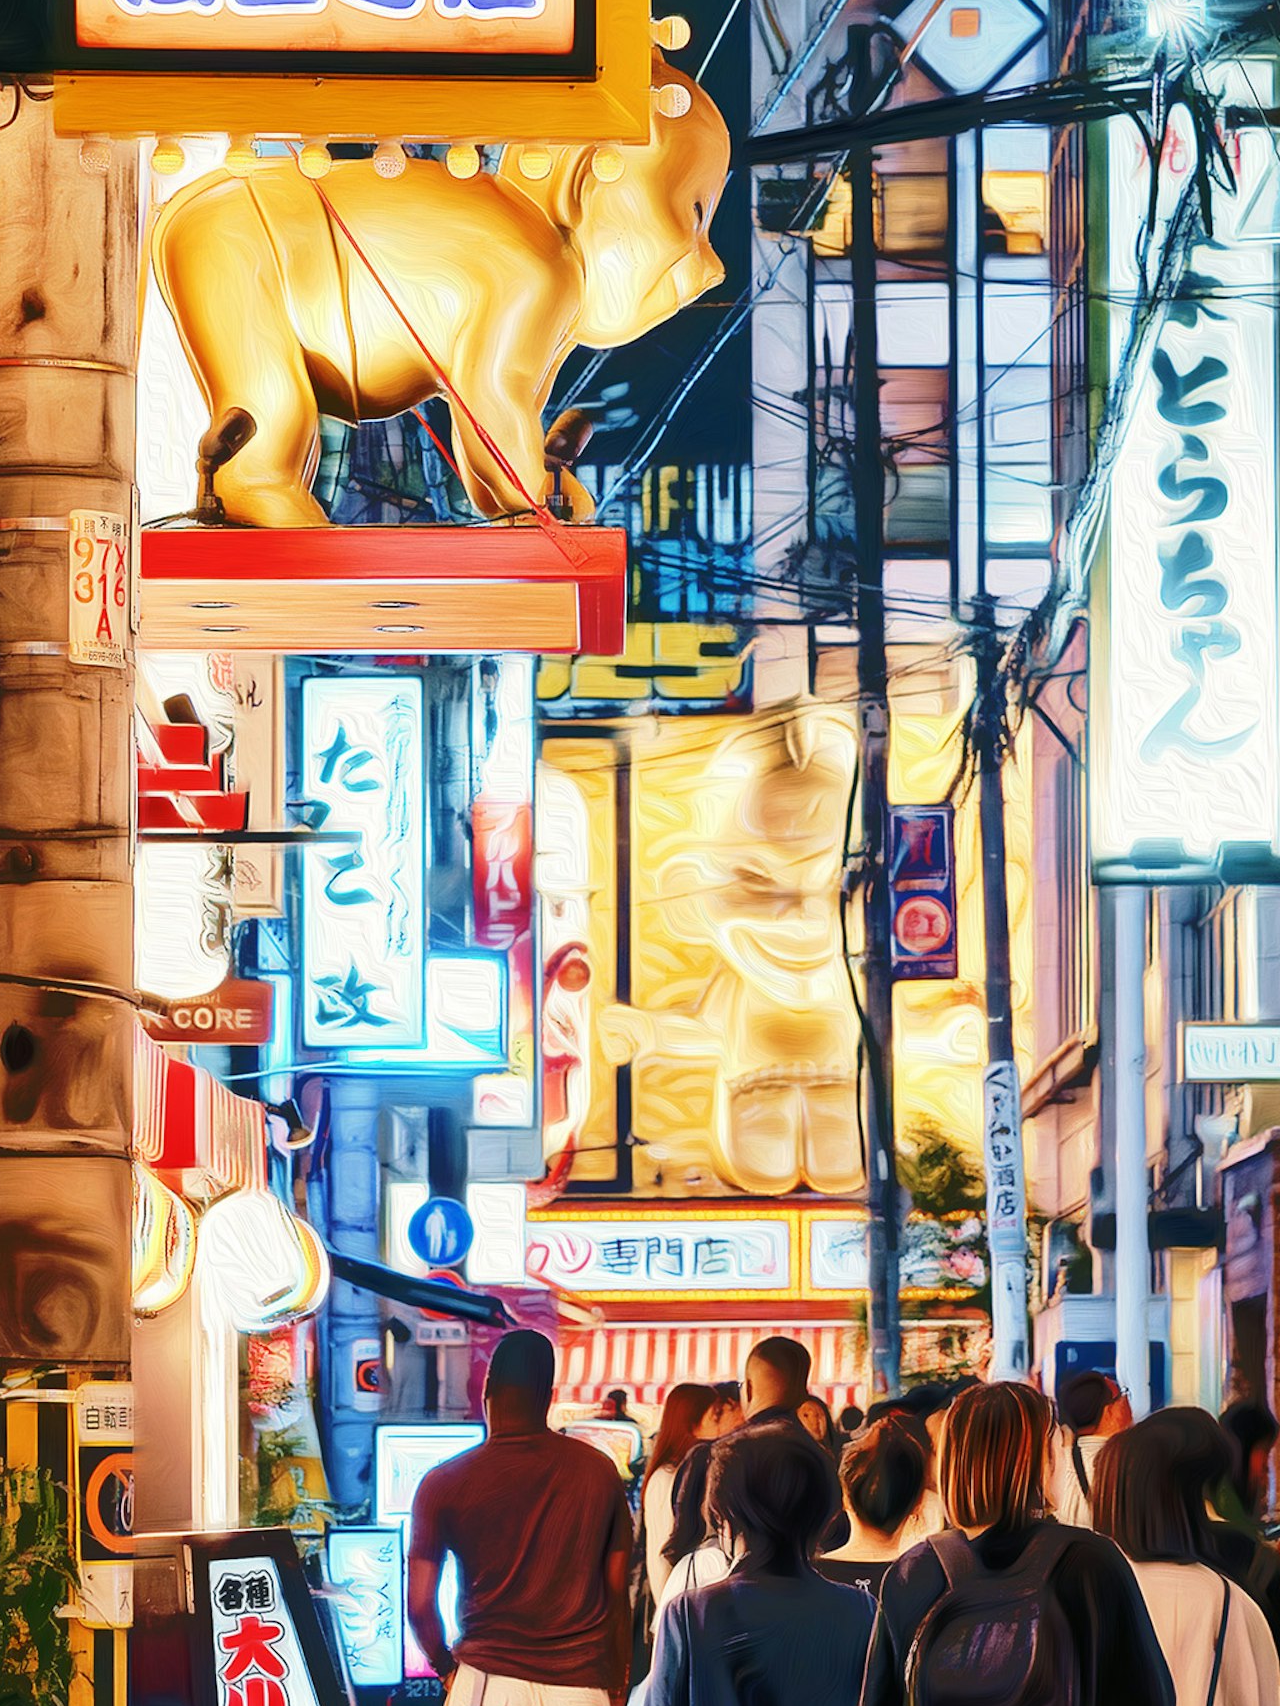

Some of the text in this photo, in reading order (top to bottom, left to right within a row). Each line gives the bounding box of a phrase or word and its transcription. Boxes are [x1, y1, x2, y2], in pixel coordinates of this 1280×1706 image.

[73, 536, 127, 575] 97X
[73, 571, 126, 608] 316
[95, 607, 113, 641] A
[172, 1007, 253, 1030] CORE
[218, 1574, 271, 1610] 各種
